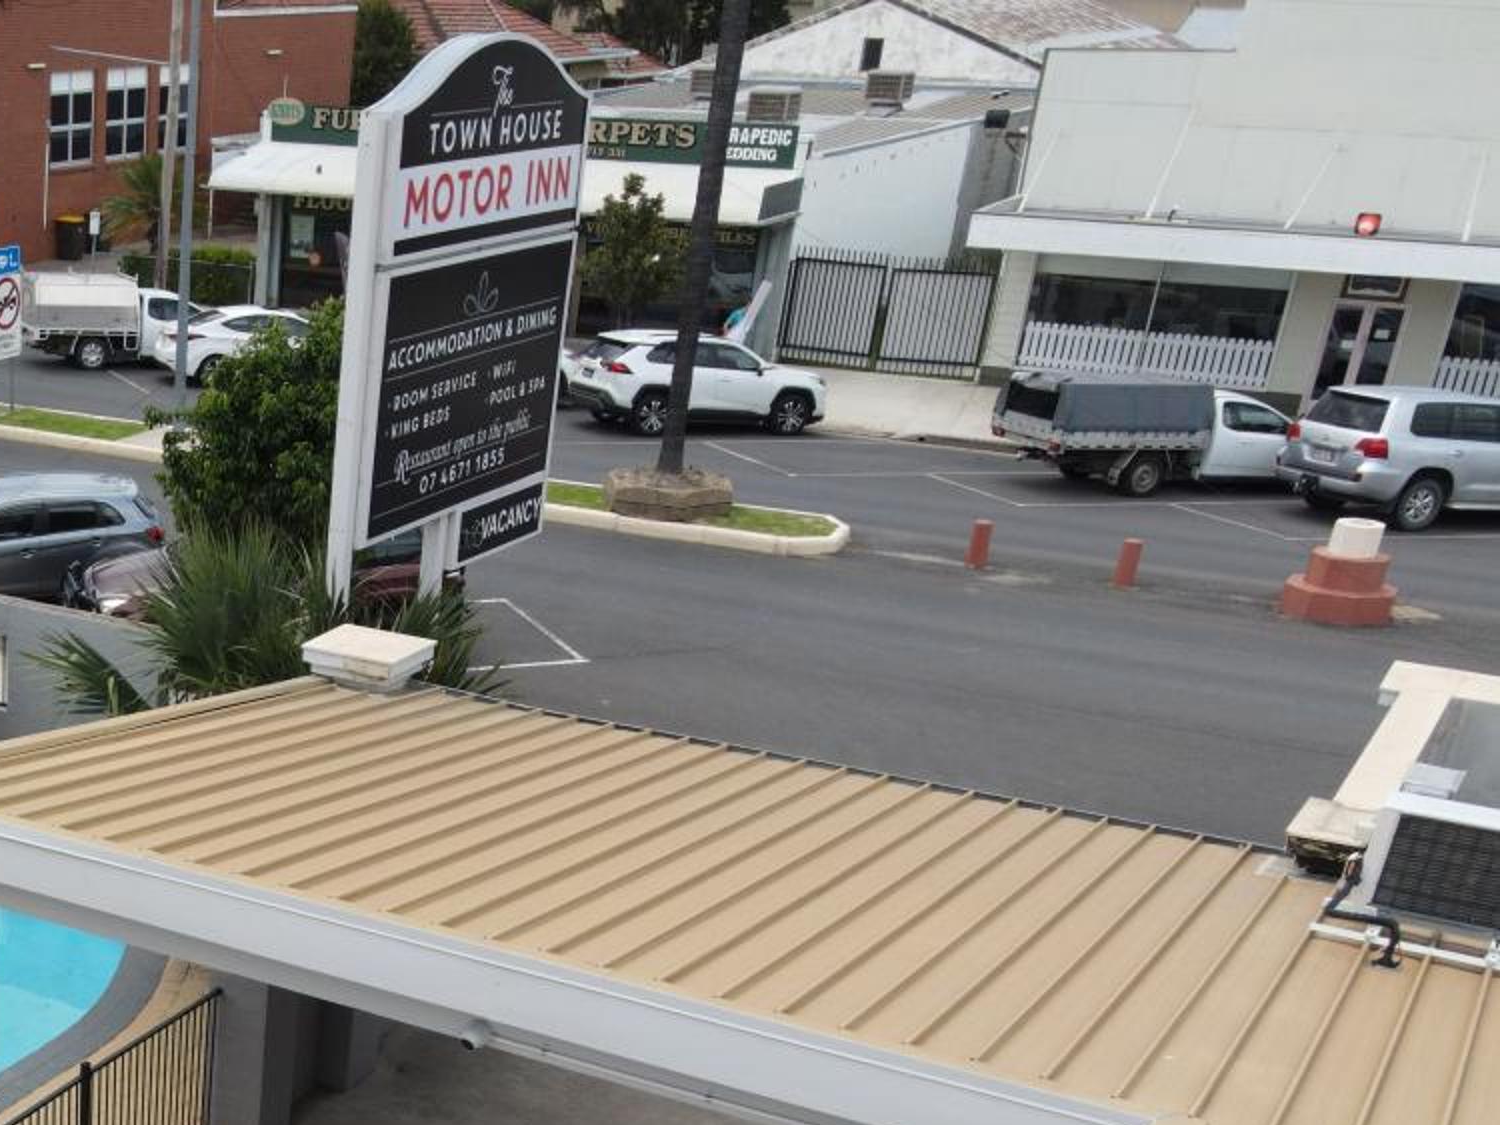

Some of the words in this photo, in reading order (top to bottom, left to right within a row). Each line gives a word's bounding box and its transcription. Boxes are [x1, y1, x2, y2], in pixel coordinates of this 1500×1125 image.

[491, 64, 515, 118] The
[429, 118, 493, 155] TOWN
[500, 109, 564, 145] HOUSE
[588, 120, 696, 148] RPETS
[725, 146, 778, 162] EDDING
[729, 127, 794, 146] RAPEDIC
[403, 164, 514, 229] MOTOR
[525, 156, 573, 206] INN
[388, 323, 503, 371] ACCOMMODATION
[504, 319, 514, 338] &
[516, 307, 558, 334] DINING
[393, 387, 429, 412] ROOM
[431, 371, 477, 400] SERVICE
[391, 416, 420, 440] KING
[423, 405, 451, 429] BEDS
[419, 471, 437, 494] 07
[440, 459, 472, 485] 4671
[473, 447, 505, 473] 1855
[481, 496, 542, 540] VACANCY
